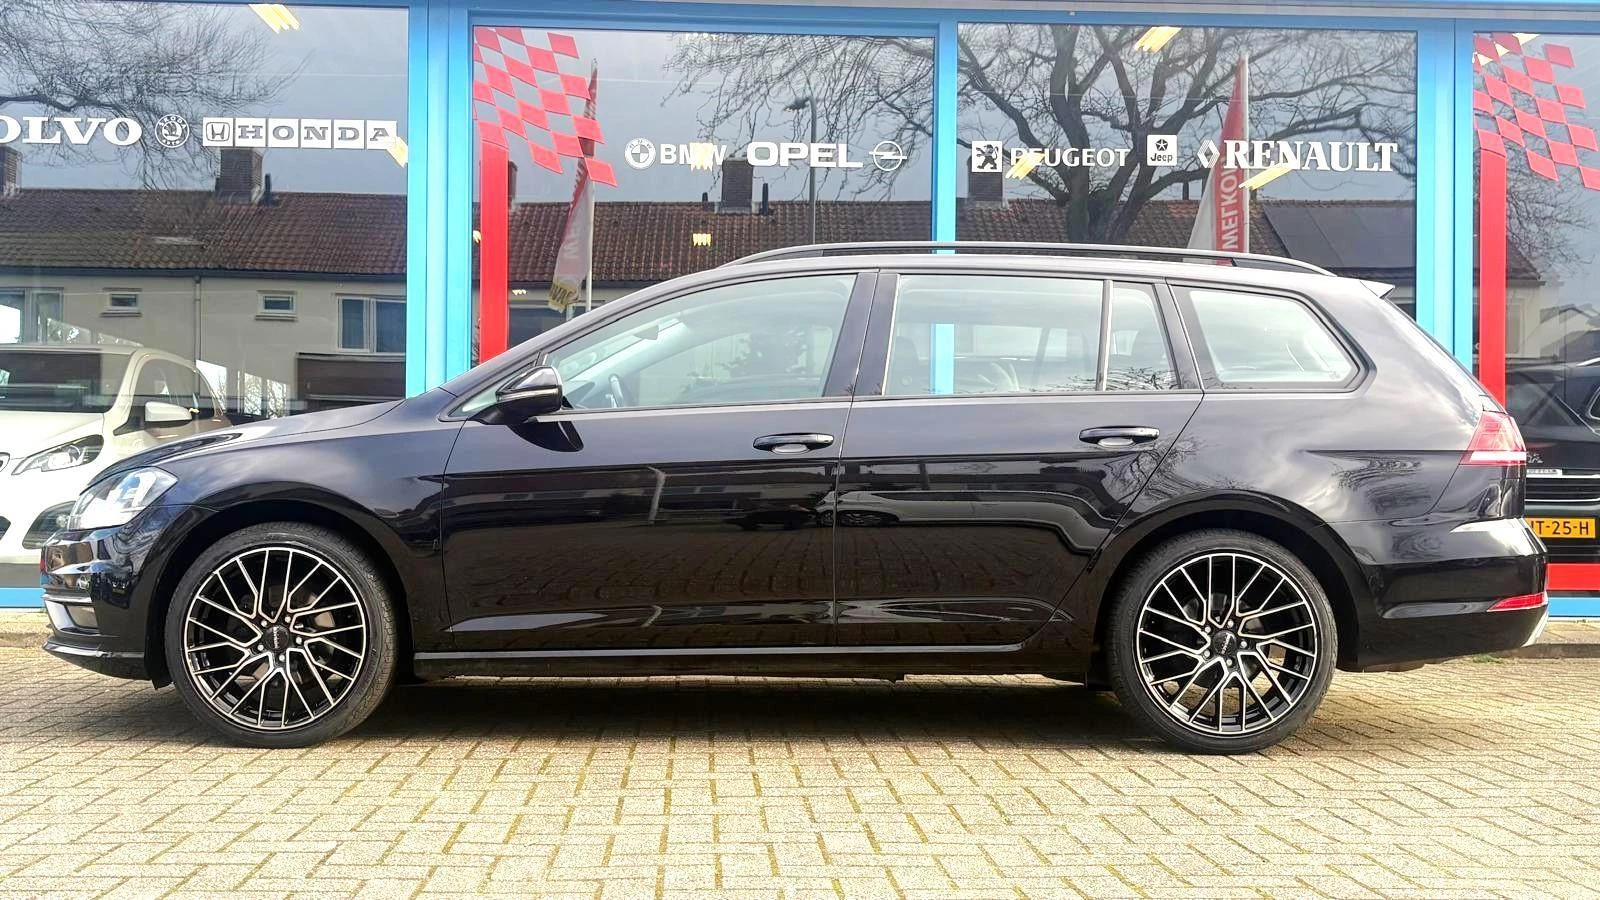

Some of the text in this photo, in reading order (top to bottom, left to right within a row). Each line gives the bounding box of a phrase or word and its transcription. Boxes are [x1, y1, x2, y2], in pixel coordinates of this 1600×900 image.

[237, 124, 393, 142] HONDA
[746, 141, 864, 168] OPEL
[1150, 152, 1174, 162] Jeep
[1223, 139, 1398, 172] RENAULT
[1530, 521, 1589, 536] T-25-H
